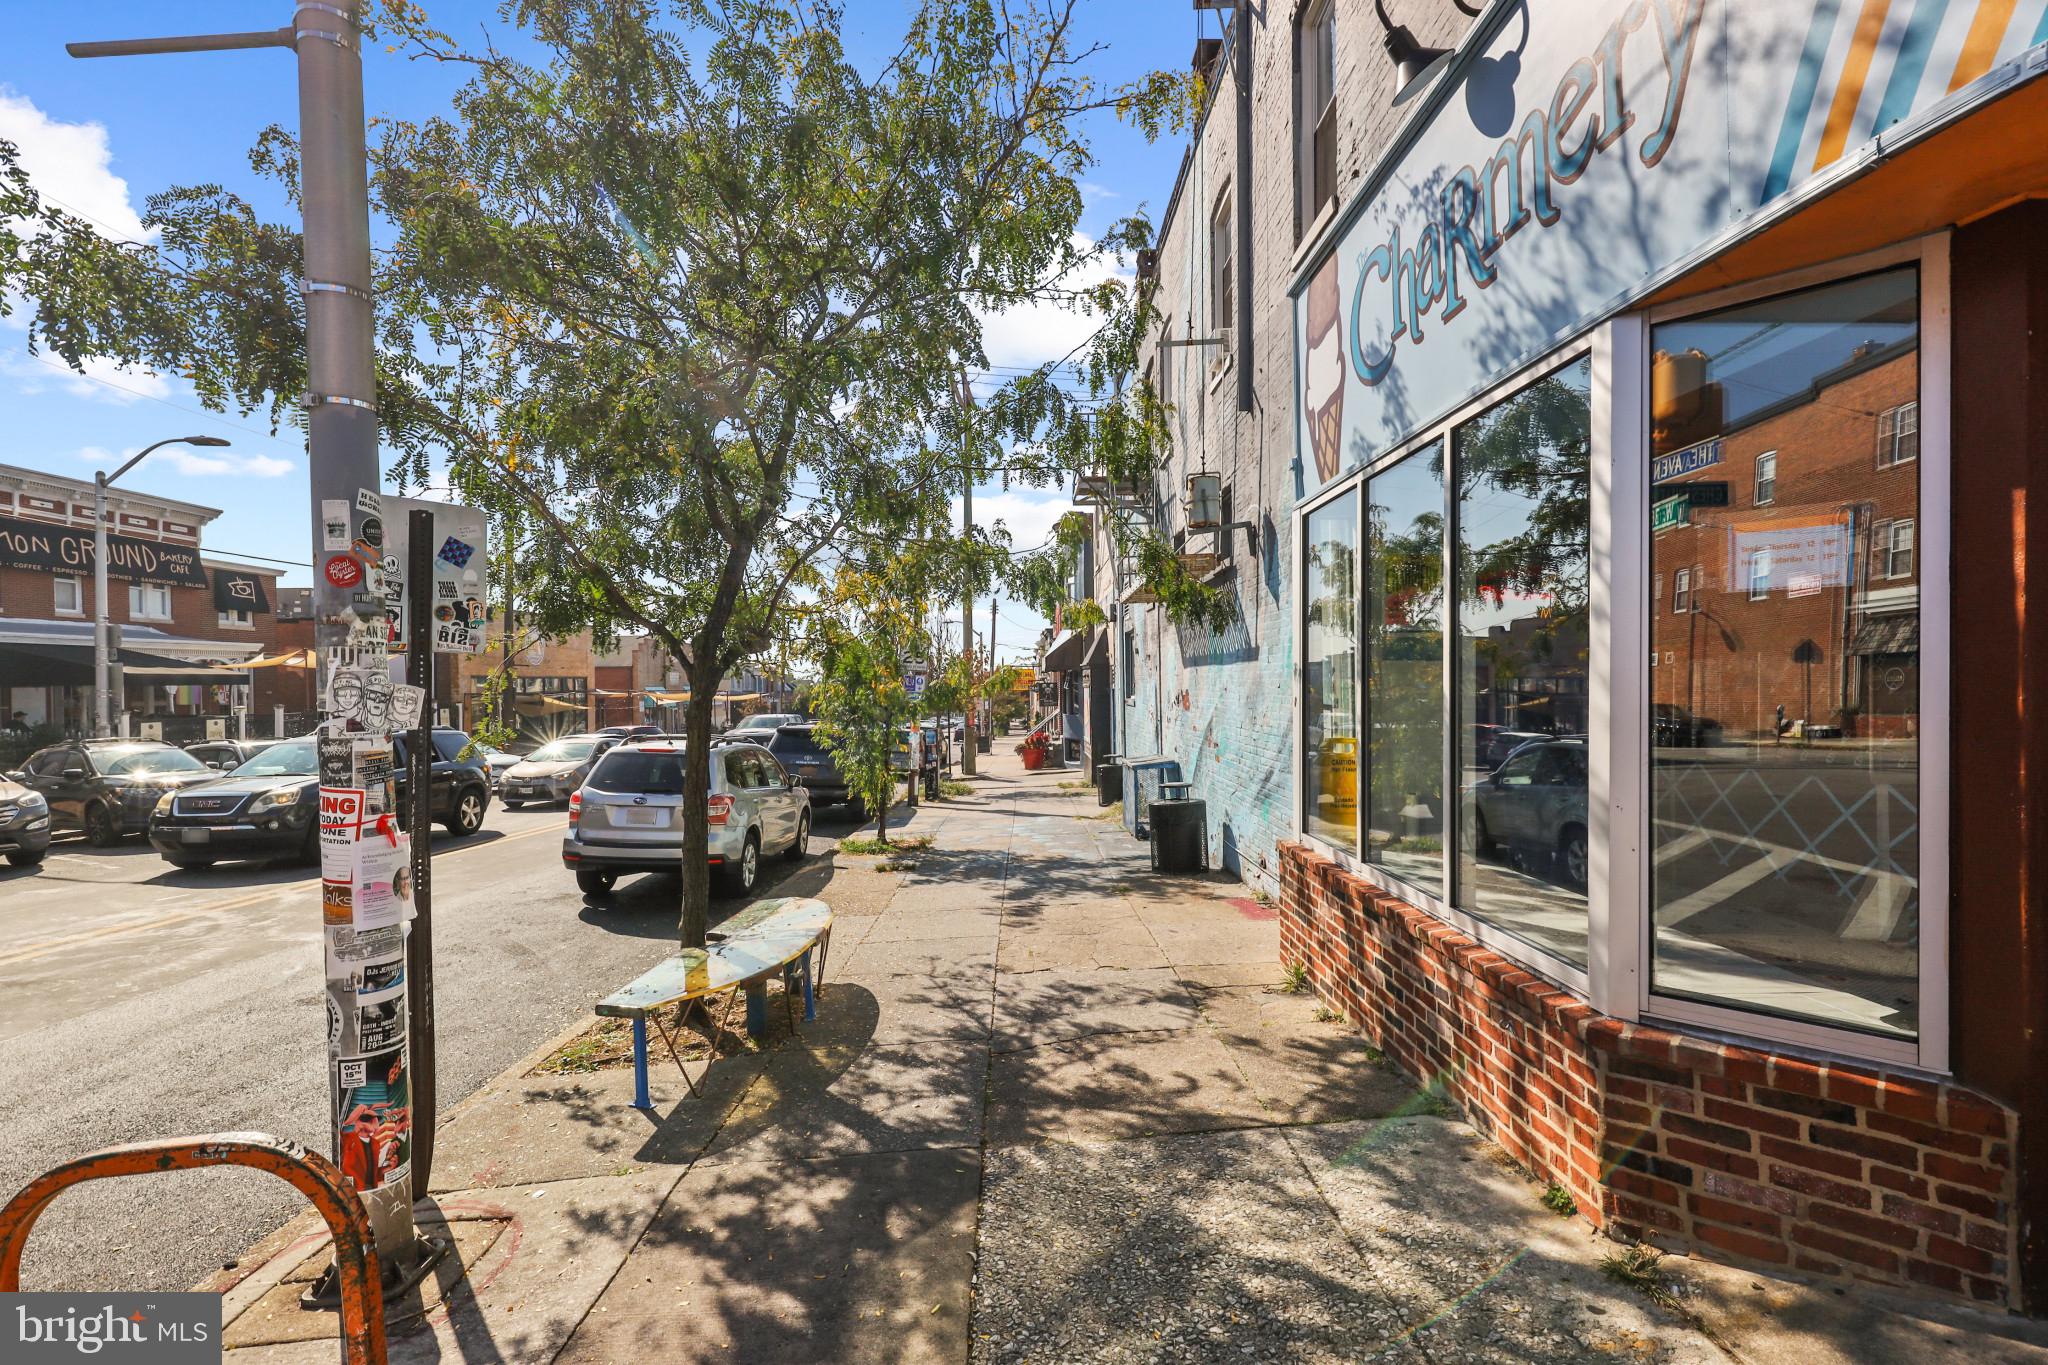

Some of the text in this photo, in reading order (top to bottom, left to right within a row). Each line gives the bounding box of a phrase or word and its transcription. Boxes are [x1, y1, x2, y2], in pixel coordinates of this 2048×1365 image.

[160, 551, 193, 565] BAKERY
[329, 560, 351, 573] Local
[13, 562, 42, 571] COFFEE
[52, 566, 88, 576] ESPRESSO
[141, 577, 178, 586] SANDWICHES
[332, 565, 356, 580] Oyster
[321, 836, 351, 846] RTATION
[367, 1033, 384, 1043] AUG
[343, 1063, 362, 1071] OCT
[344, 1070, 362, 1078] 15TH
